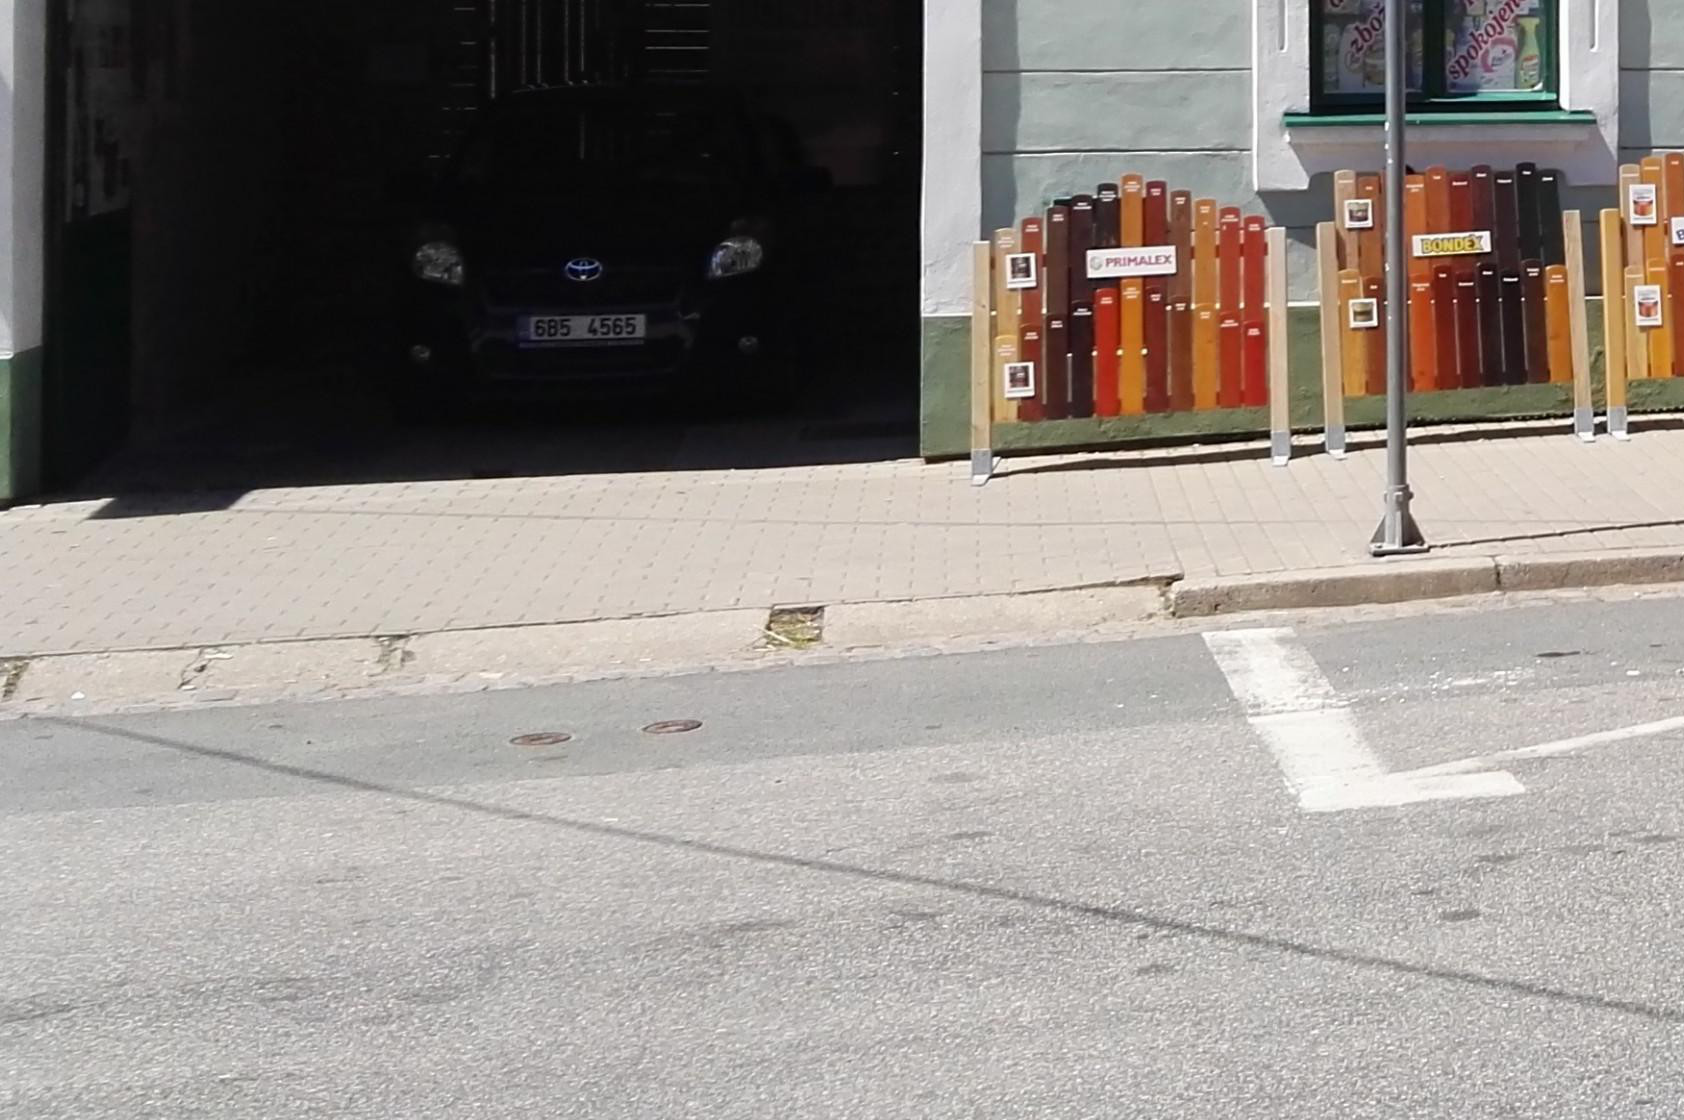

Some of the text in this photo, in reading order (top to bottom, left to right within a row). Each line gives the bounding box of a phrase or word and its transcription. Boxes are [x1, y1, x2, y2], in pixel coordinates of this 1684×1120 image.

[1420, 234, 1484, 254] BONDEX
[1105, 254, 1173, 269] PRIMALEX
[534, 316, 637, 337] 6B5 4565
